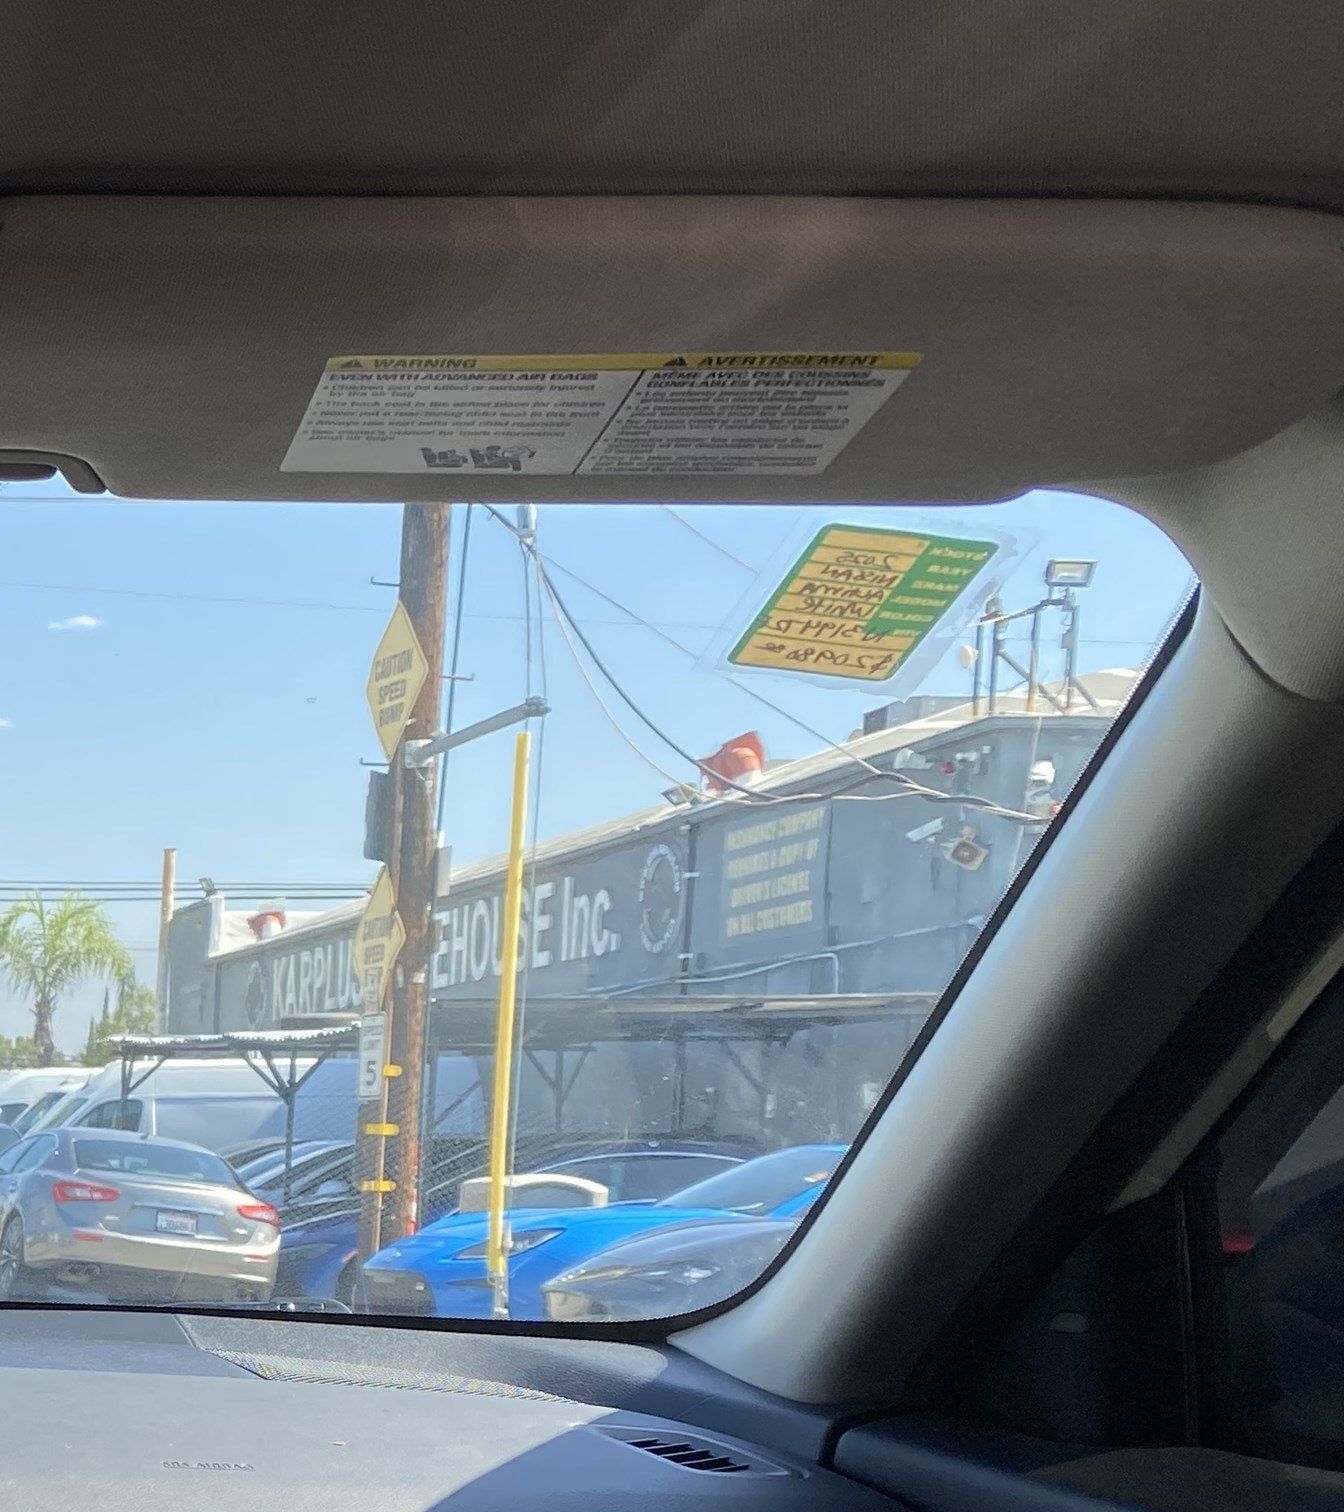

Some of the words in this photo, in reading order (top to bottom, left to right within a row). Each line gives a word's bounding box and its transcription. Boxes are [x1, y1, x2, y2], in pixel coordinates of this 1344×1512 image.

[374, 359, 478, 369] WARNING
[698, 355, 885, 367] AVERTISSEMENT
[374, 648, 414, 682] CAUTION
[378, 679, 407, 705] SPEED
[378, 702, 404, 728] BUMP
[561, 876, 622, 961] Inc.
[364, 943, 385, 965] SPEED
[365, 1060, 377, 1086] 5
